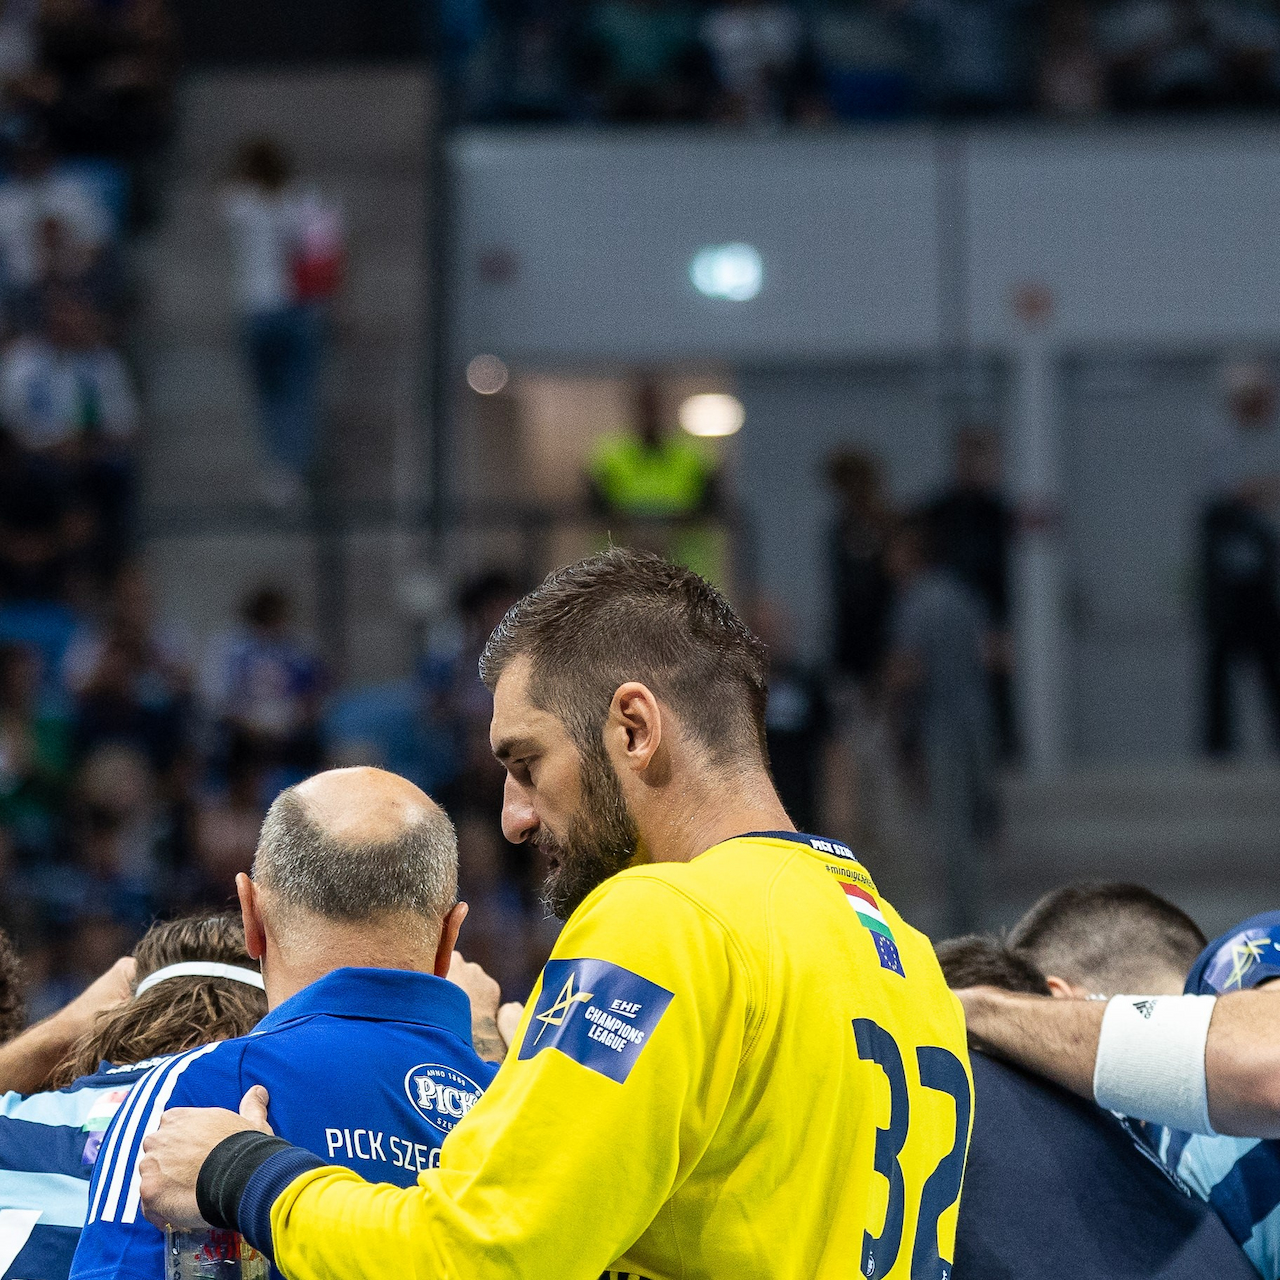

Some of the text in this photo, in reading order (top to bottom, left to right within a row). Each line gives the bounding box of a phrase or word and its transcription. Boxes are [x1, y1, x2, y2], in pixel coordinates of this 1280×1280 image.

[611, 999, 642, 1014] EHF
[584, 1005, 645, 1045] CHAMPIONS
[587, 1024, 628, 1053] LEAGUE
[324, 1128, 387, 1162] PICK
